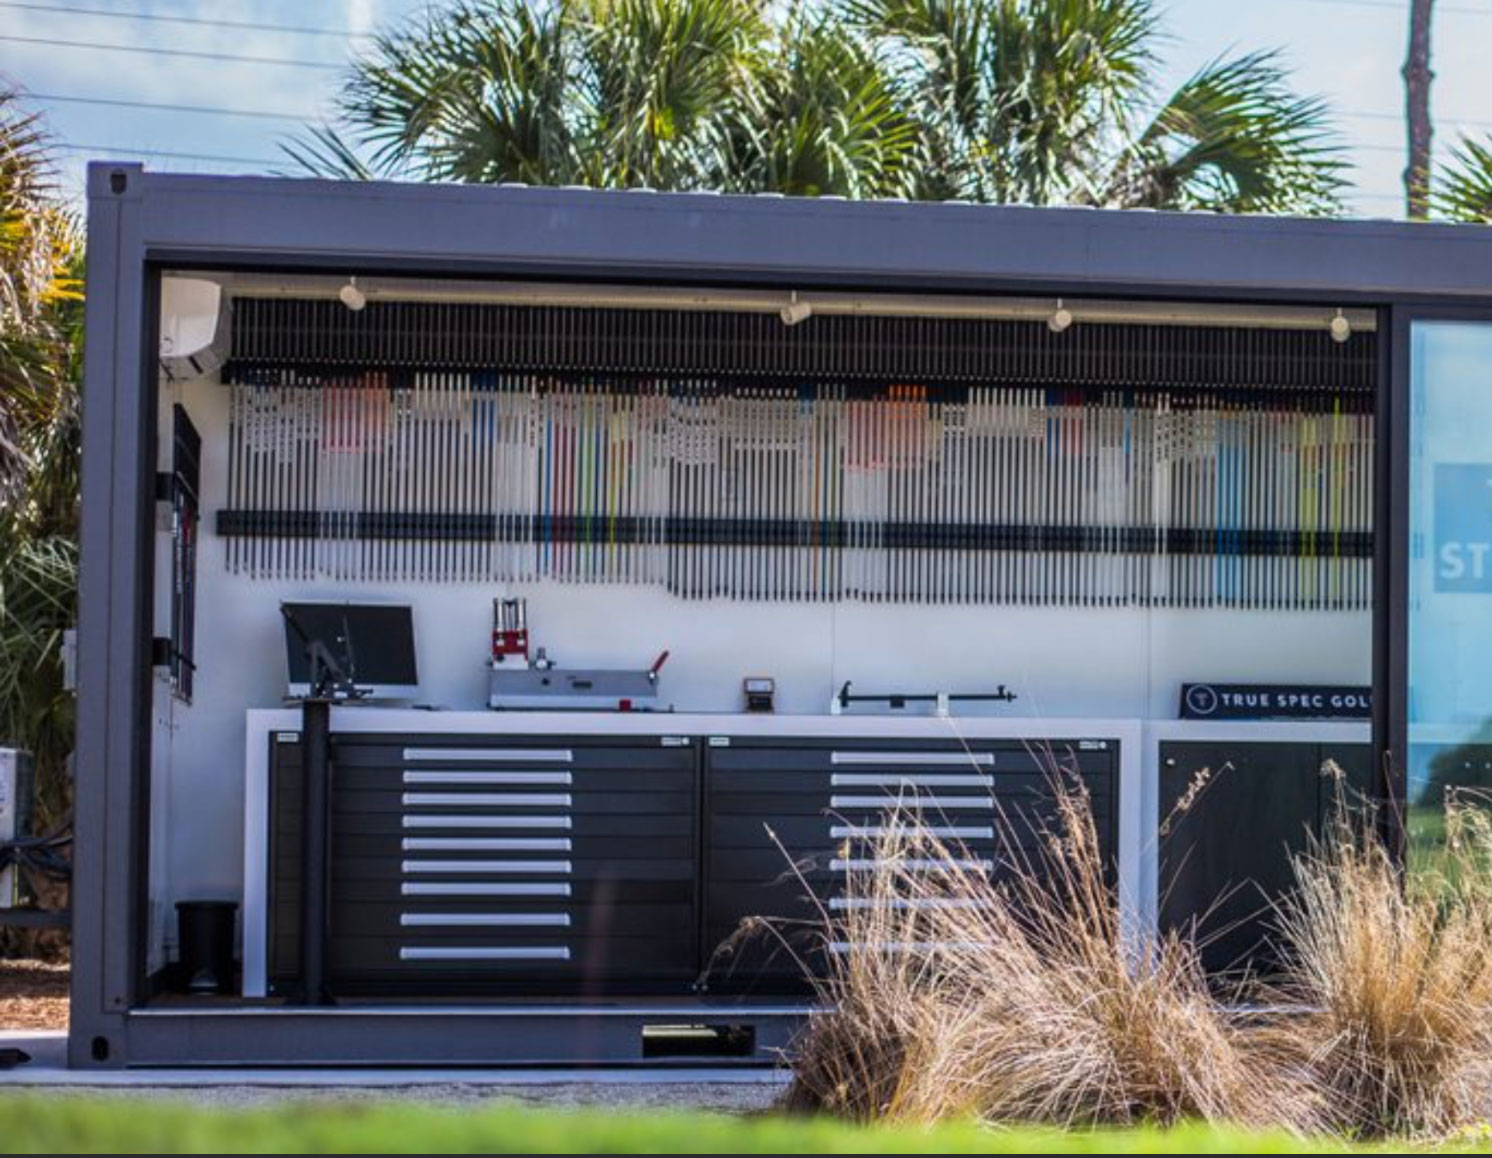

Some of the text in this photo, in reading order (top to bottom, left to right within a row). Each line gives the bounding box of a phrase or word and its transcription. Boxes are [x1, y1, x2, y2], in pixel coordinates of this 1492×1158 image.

[1222, 693, 1270, 707] TRUE
[1277, 694, 1323, 708] SPEC
[1330, 695, 1373, 708] GOL
